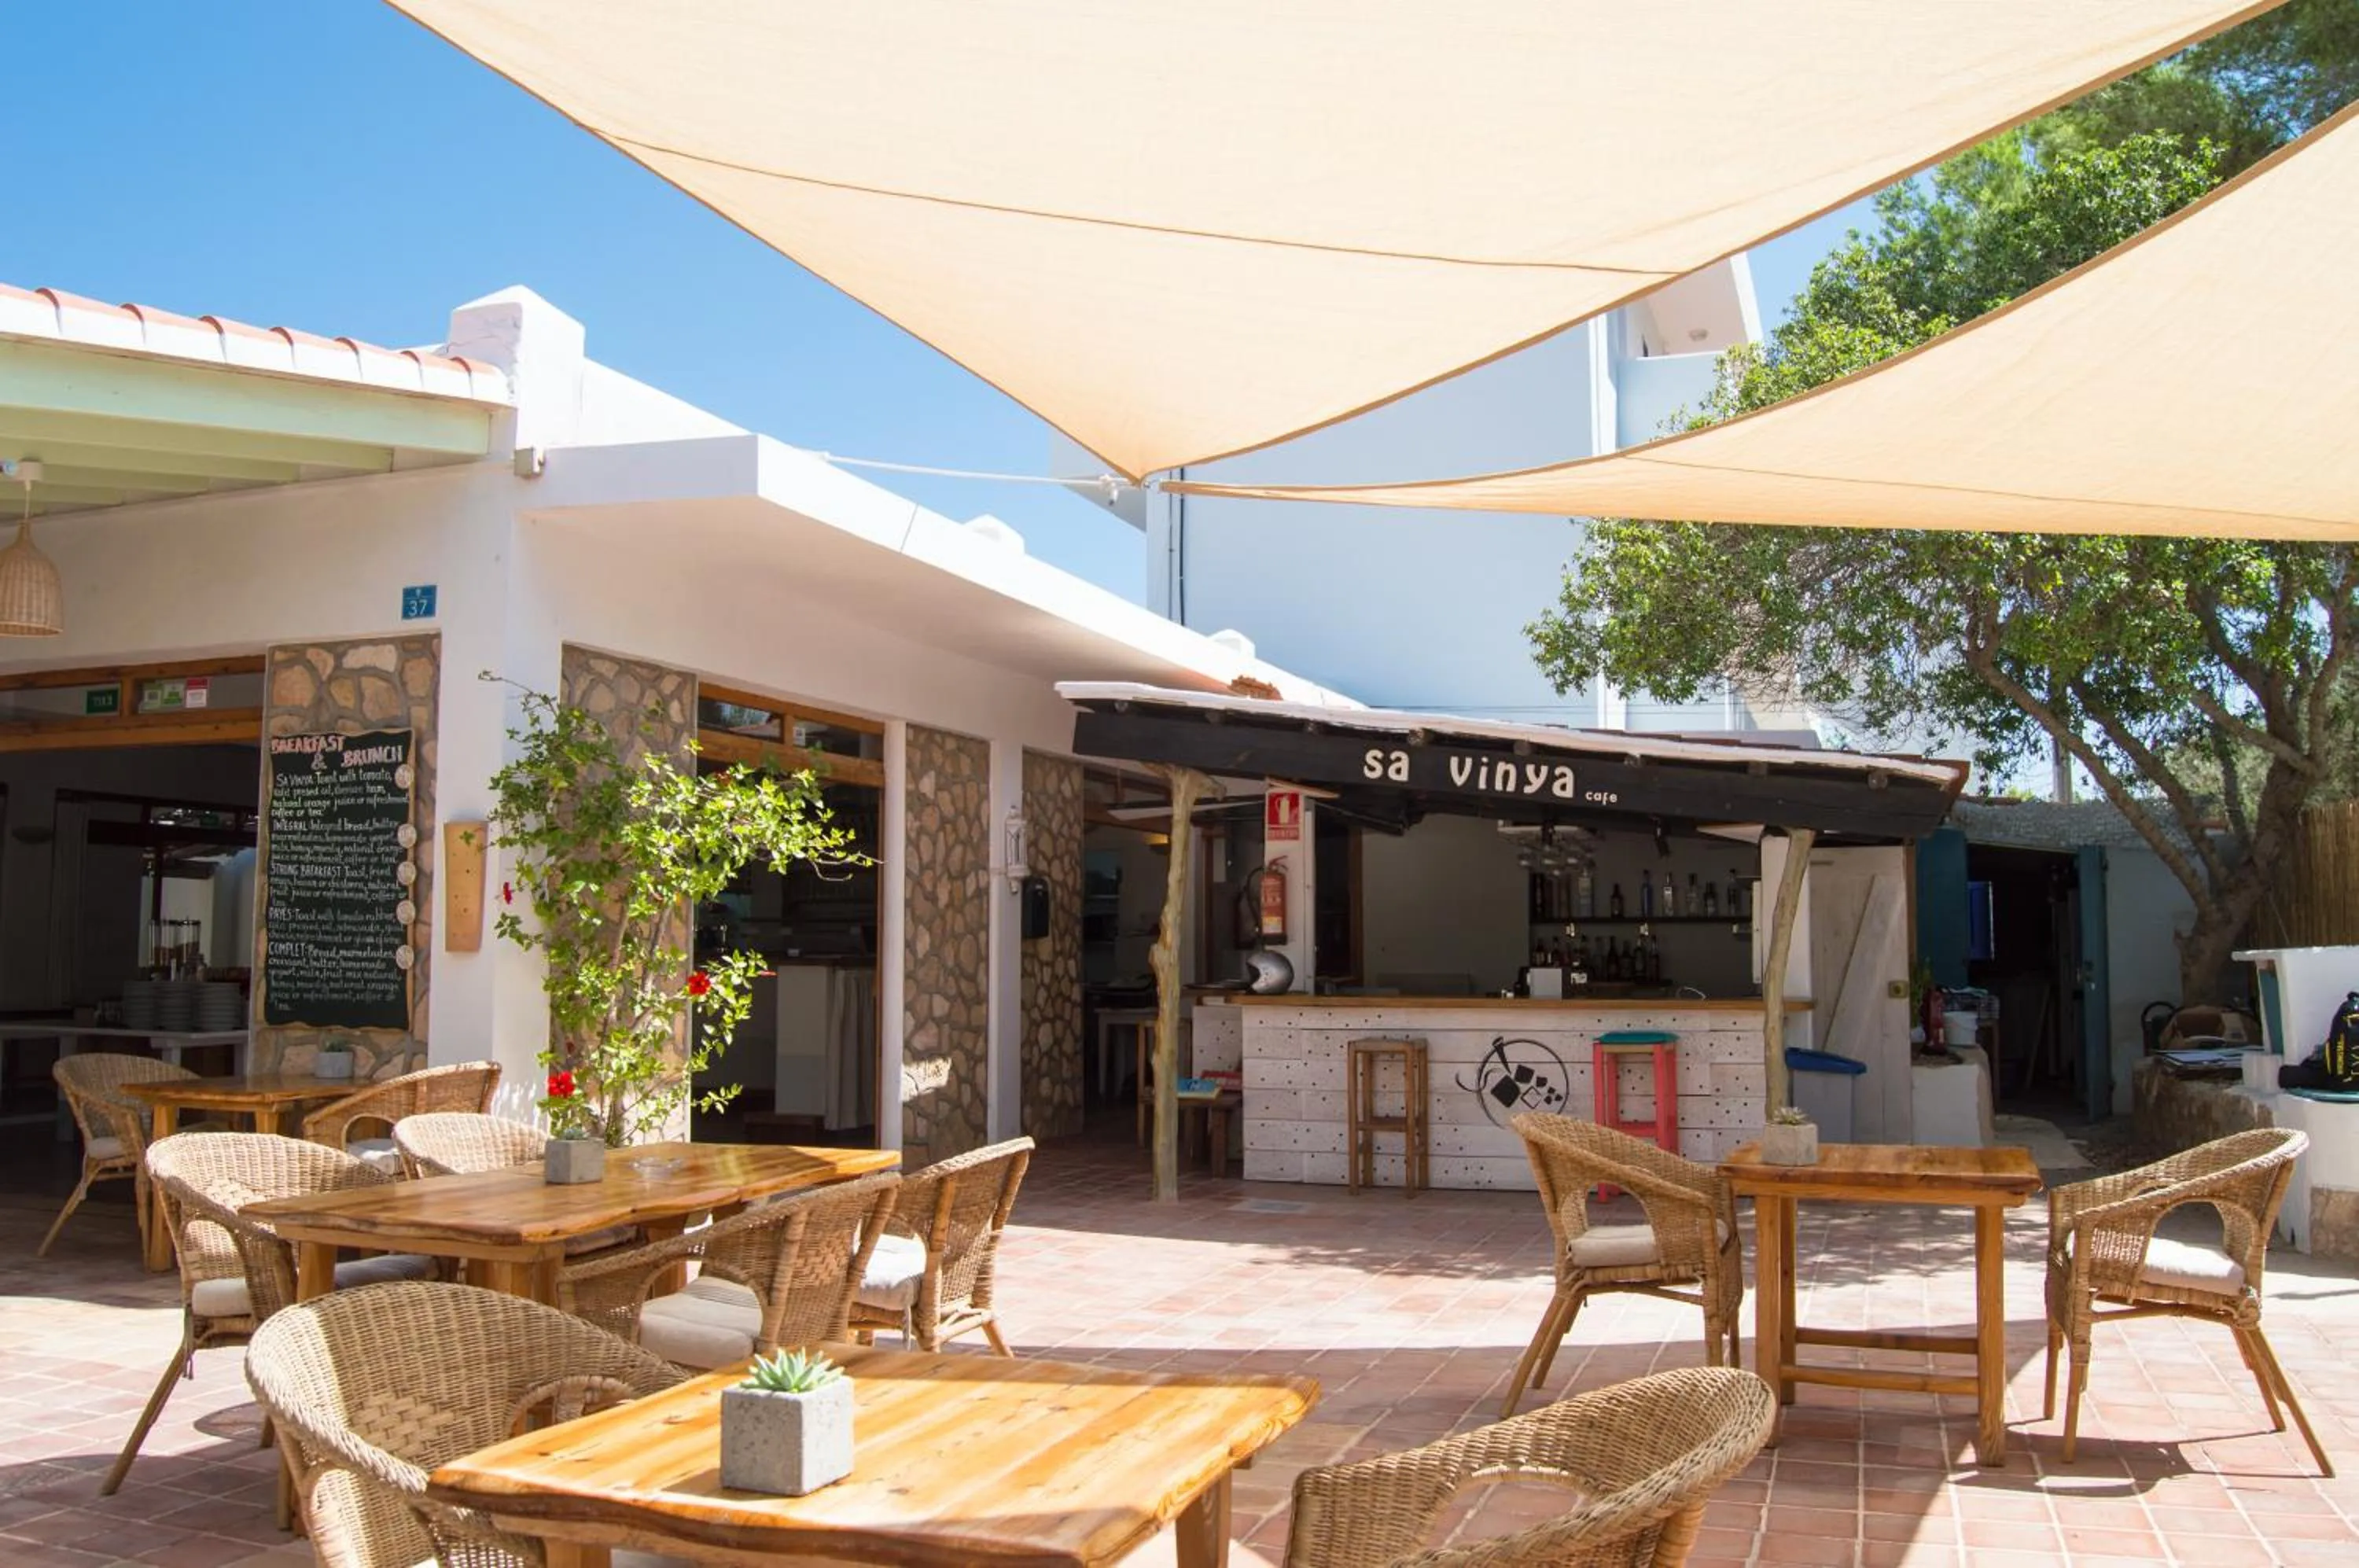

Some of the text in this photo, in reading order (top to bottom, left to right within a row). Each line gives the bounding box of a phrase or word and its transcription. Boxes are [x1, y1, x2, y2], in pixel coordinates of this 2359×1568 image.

[409, 599, 428, 617] 37
[271, 735, 346, 754] BREAKFAST
[311, 745, 403, 770] & BRUNCH
[1364, 749, 1617, 806] sa vinya cafe
